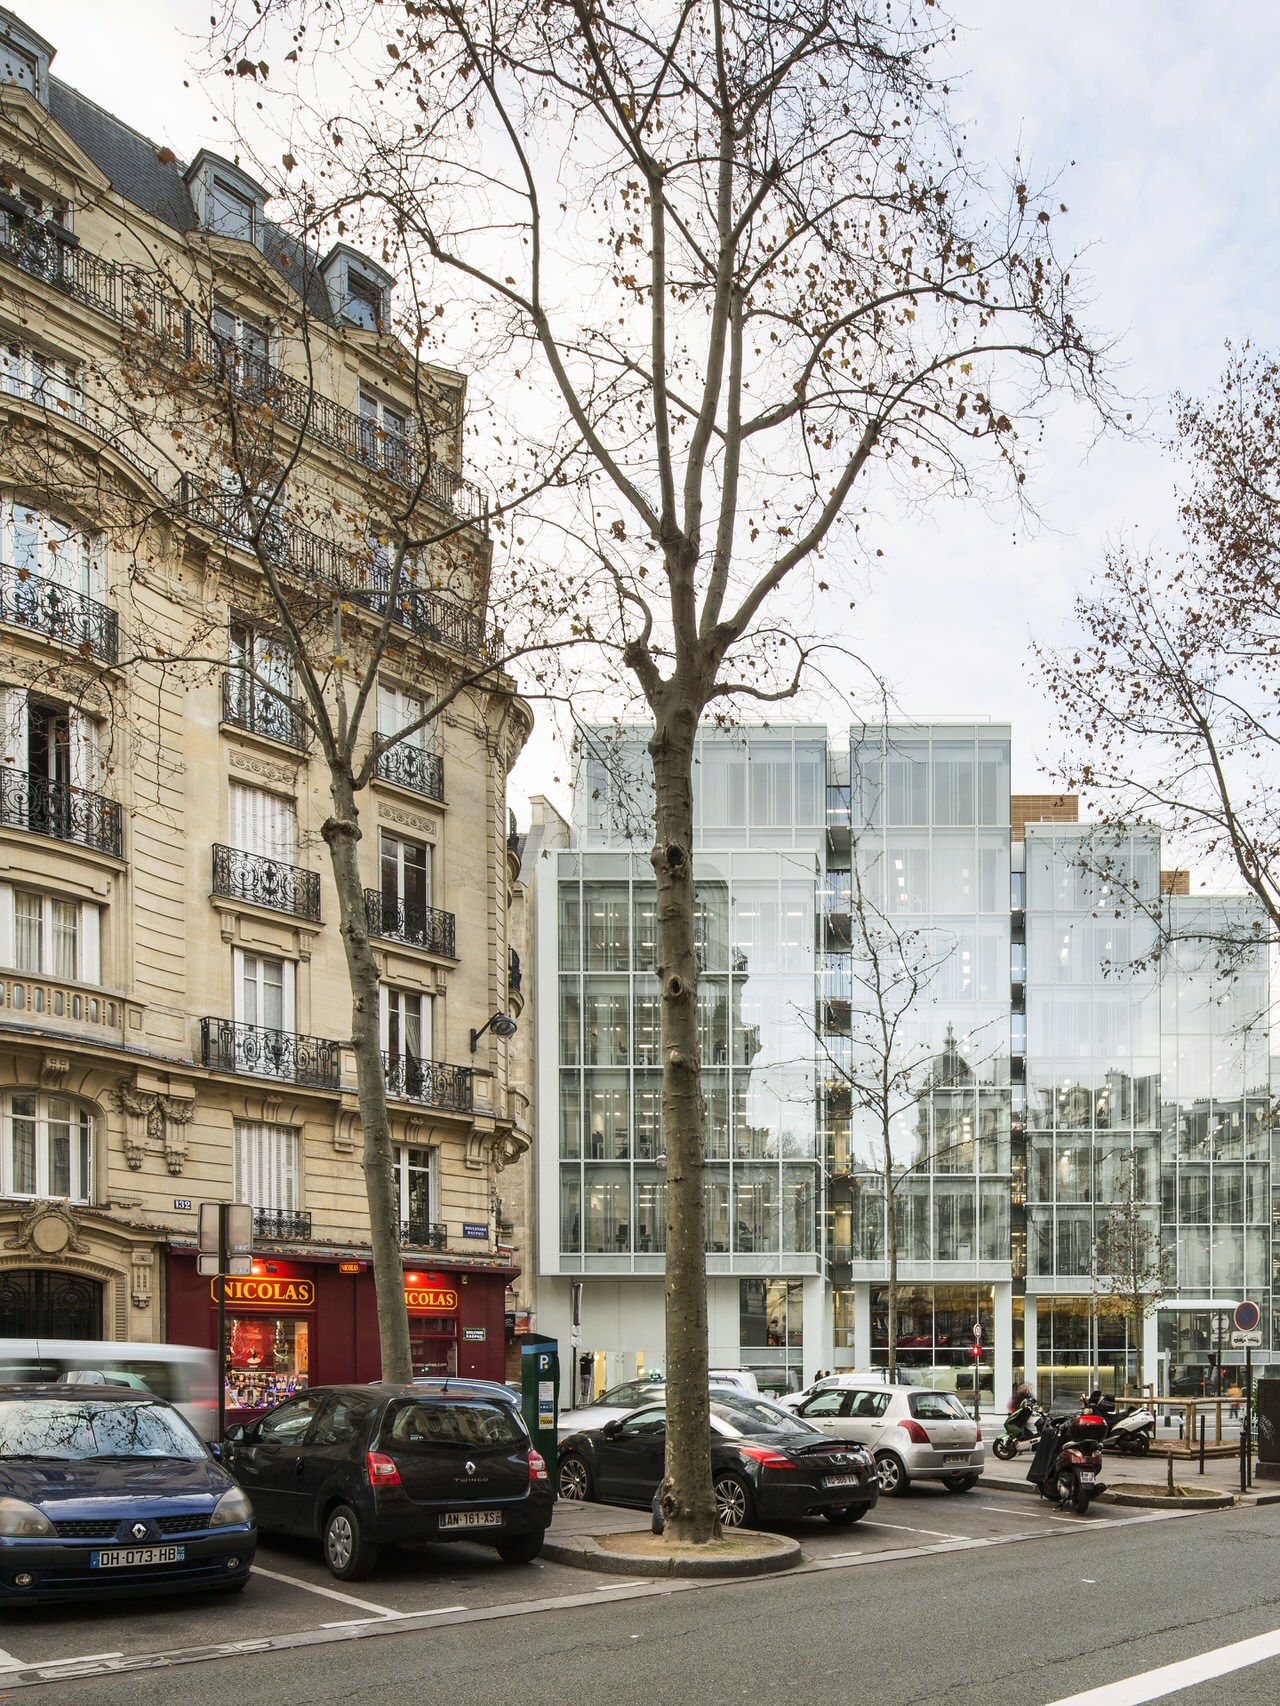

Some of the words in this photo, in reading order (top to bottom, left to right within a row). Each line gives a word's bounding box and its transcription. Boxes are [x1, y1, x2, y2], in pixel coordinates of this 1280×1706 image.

[175, 1200, 191, 1209] 132
[224, 1281, 309, 1300] NICOLAS
[404, 1292, 454, 1306] ICOLAS
[540, 1355, 549, 1369] P
[447, 1512, 495, 1525] AN-161-XS
[101, 1548, 176, 1566] DH-073-HB
